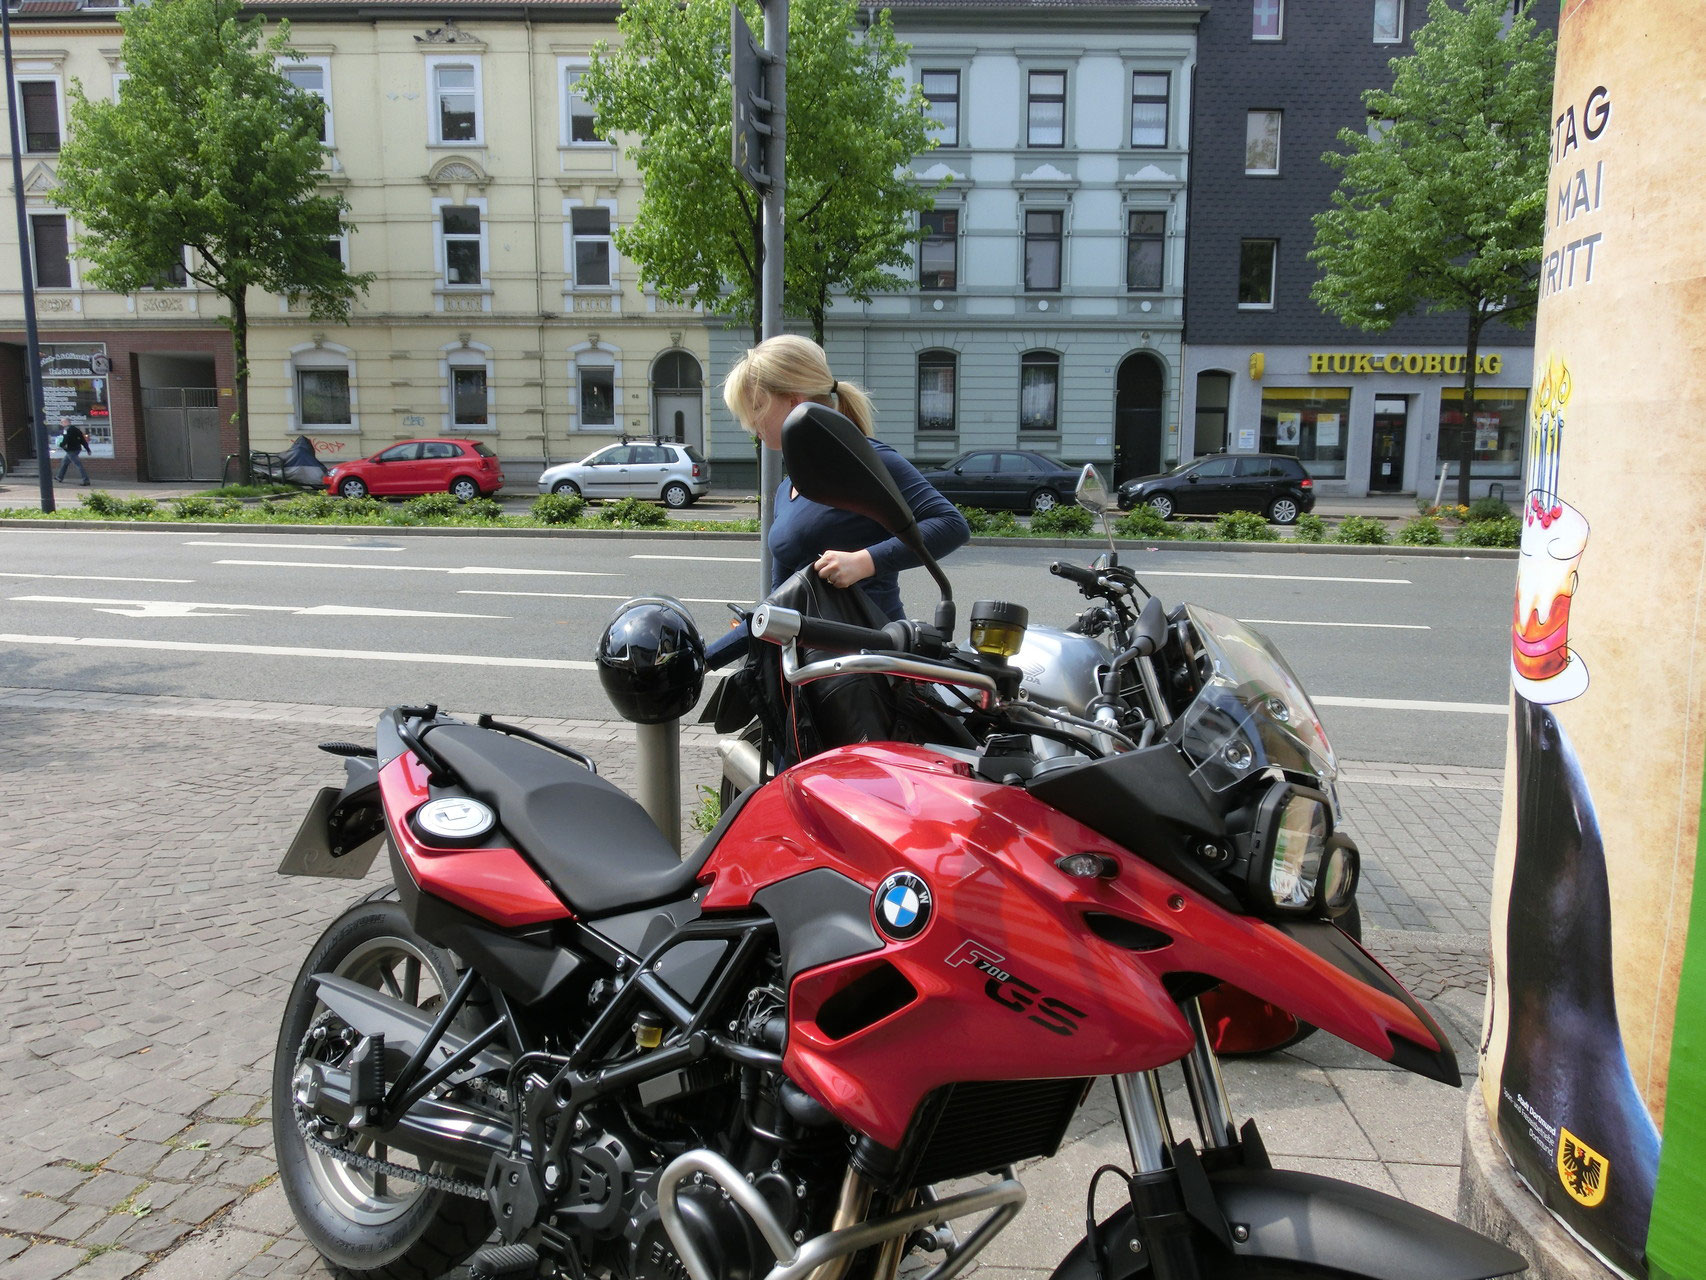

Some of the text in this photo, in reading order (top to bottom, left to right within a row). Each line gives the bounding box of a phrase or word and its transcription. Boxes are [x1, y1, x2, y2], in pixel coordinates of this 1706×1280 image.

[1556, 160, 1603, 227] MAI
[1540, 232, 1602, 299] TRITT
[885, 876, 930, 904] BMW
[944, 939, 1006, 968] F
[978, 961, 1010, 983] 700
[984, 972, 1088, 1036] GS
[1517, 1093, 1557, 1136] Stadt Dortmund
[1528, 1128, 1554, 1157] Dortmund
